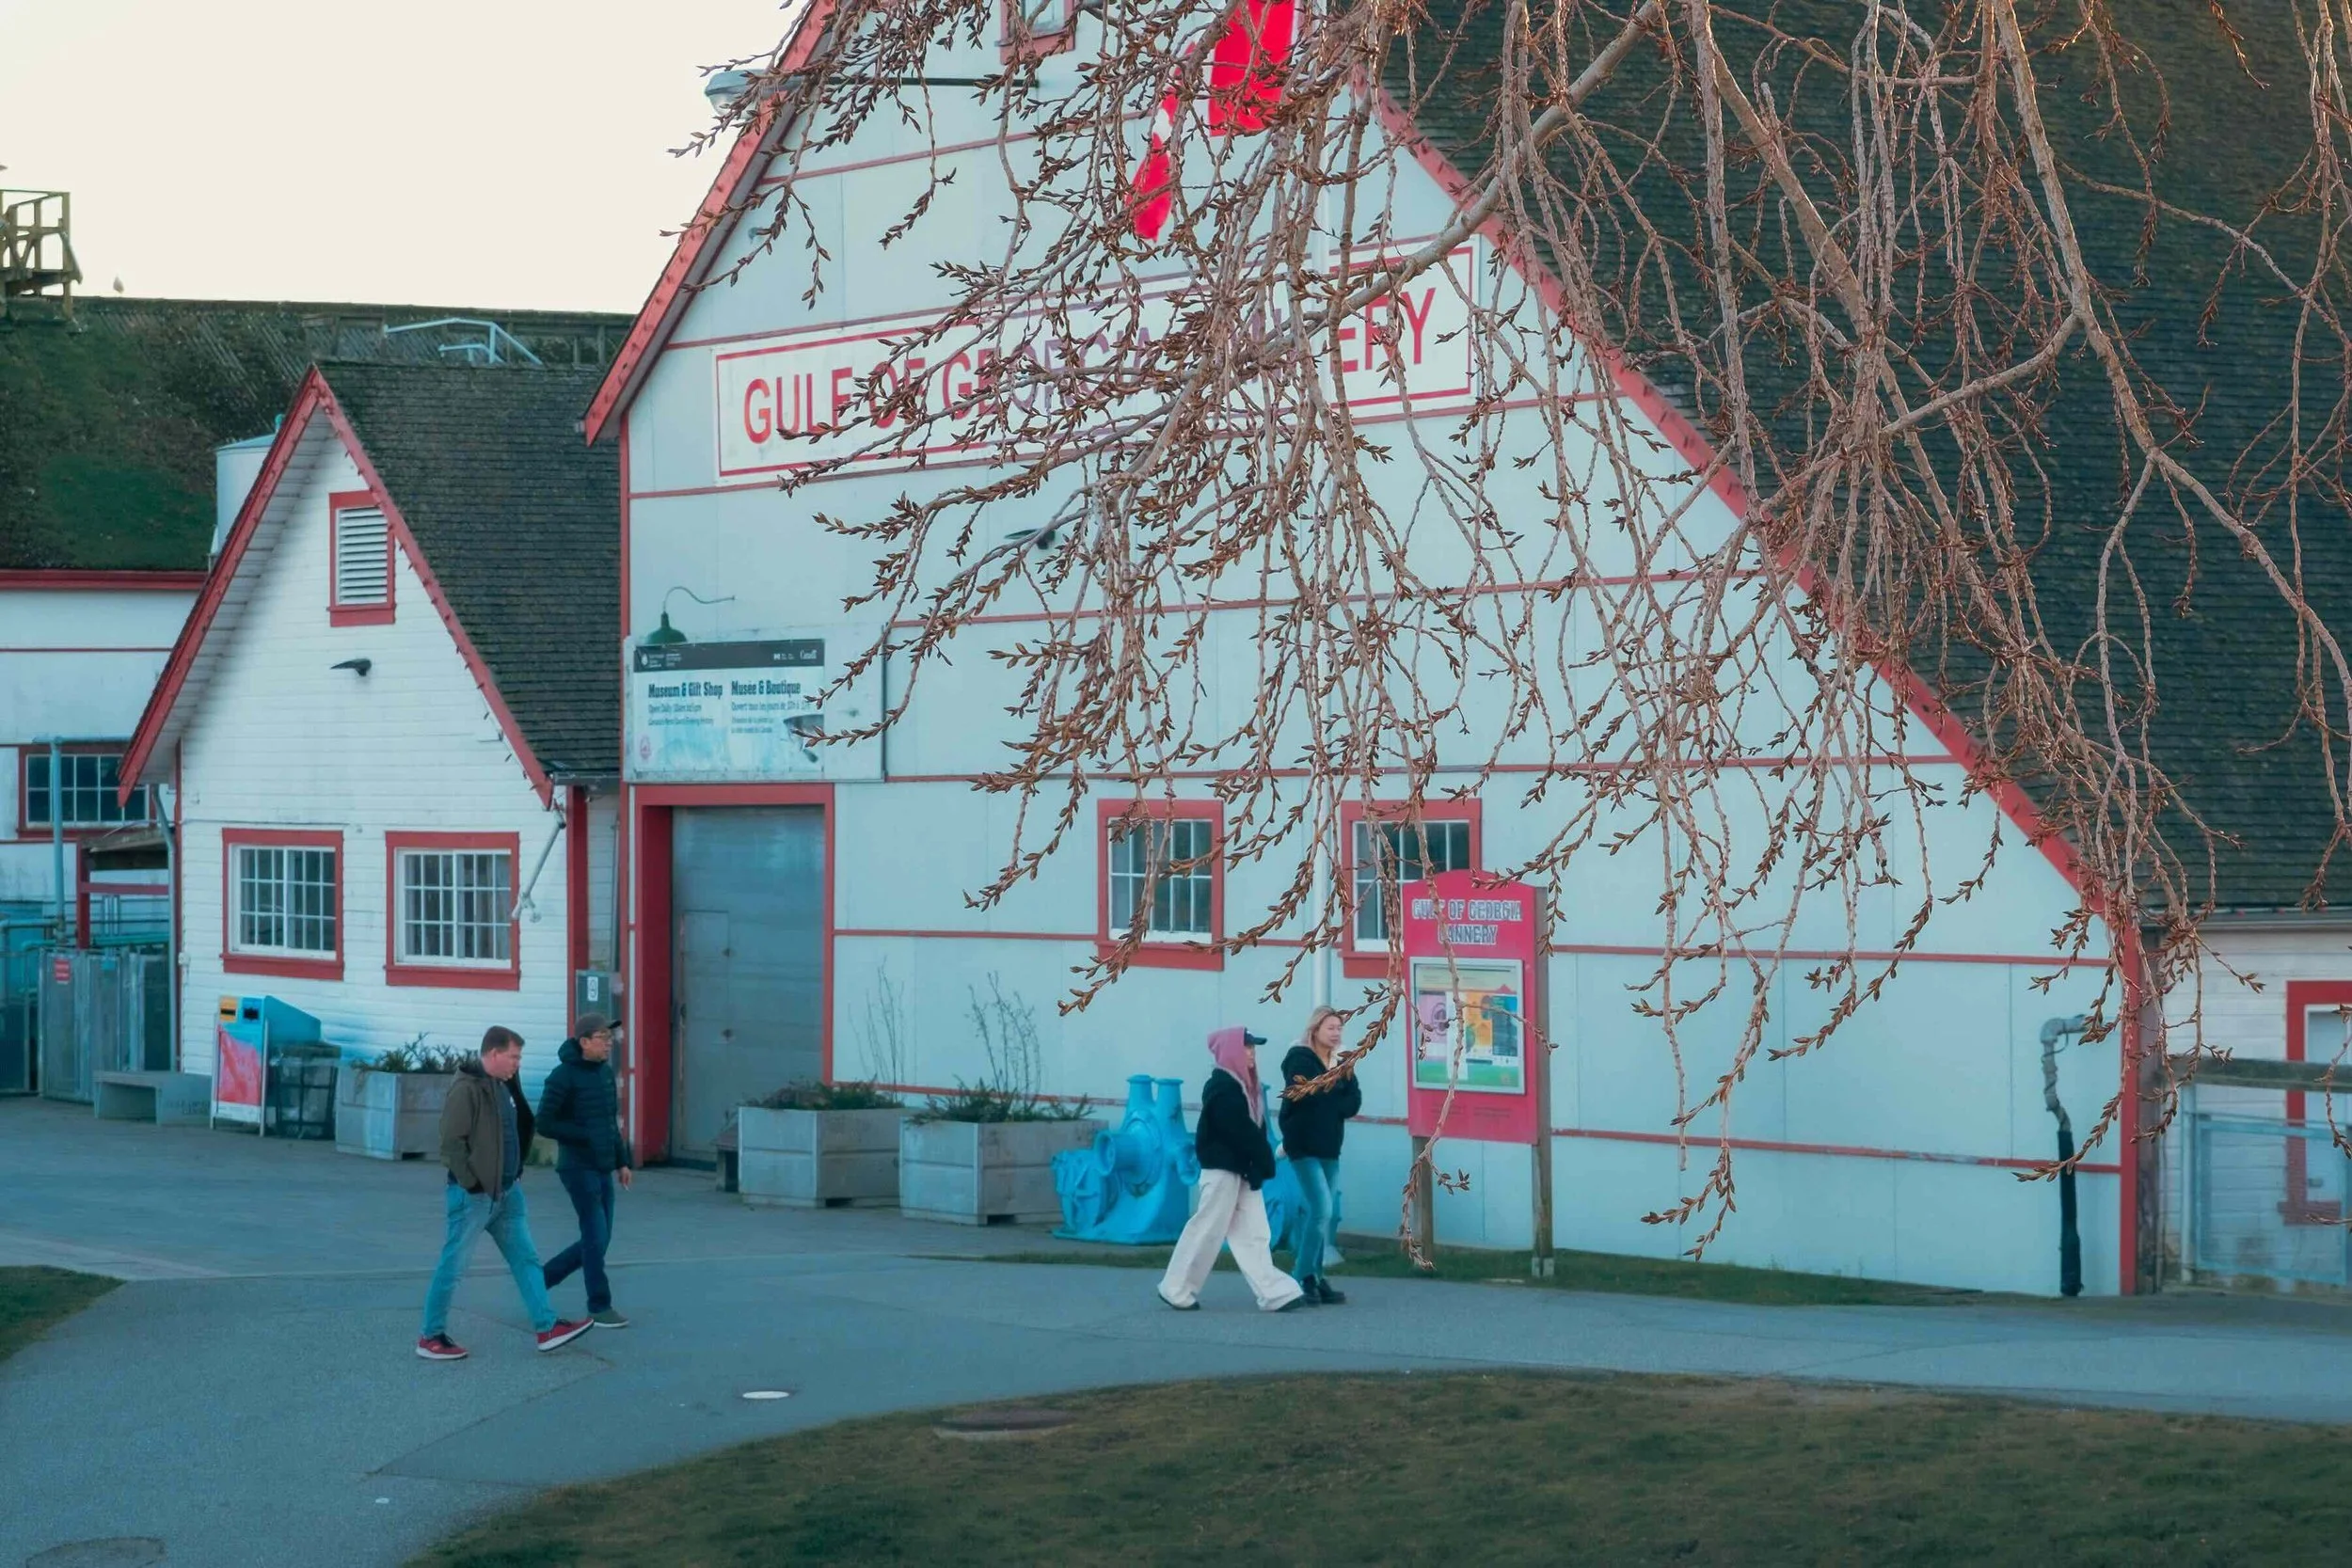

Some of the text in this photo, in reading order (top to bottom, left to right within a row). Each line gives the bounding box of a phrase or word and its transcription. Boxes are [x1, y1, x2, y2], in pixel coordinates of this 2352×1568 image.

[743, 367, 853, 444] GULF
[868, 357, 926, 429] OF
[648, 681, 723, 700] Museum & Gift Shop
[731, 679, 802, 697] Musée & Boutique
[1448, 899, 1465, 920] OF
[1469, 900, 1522, 921] GEORGIA
